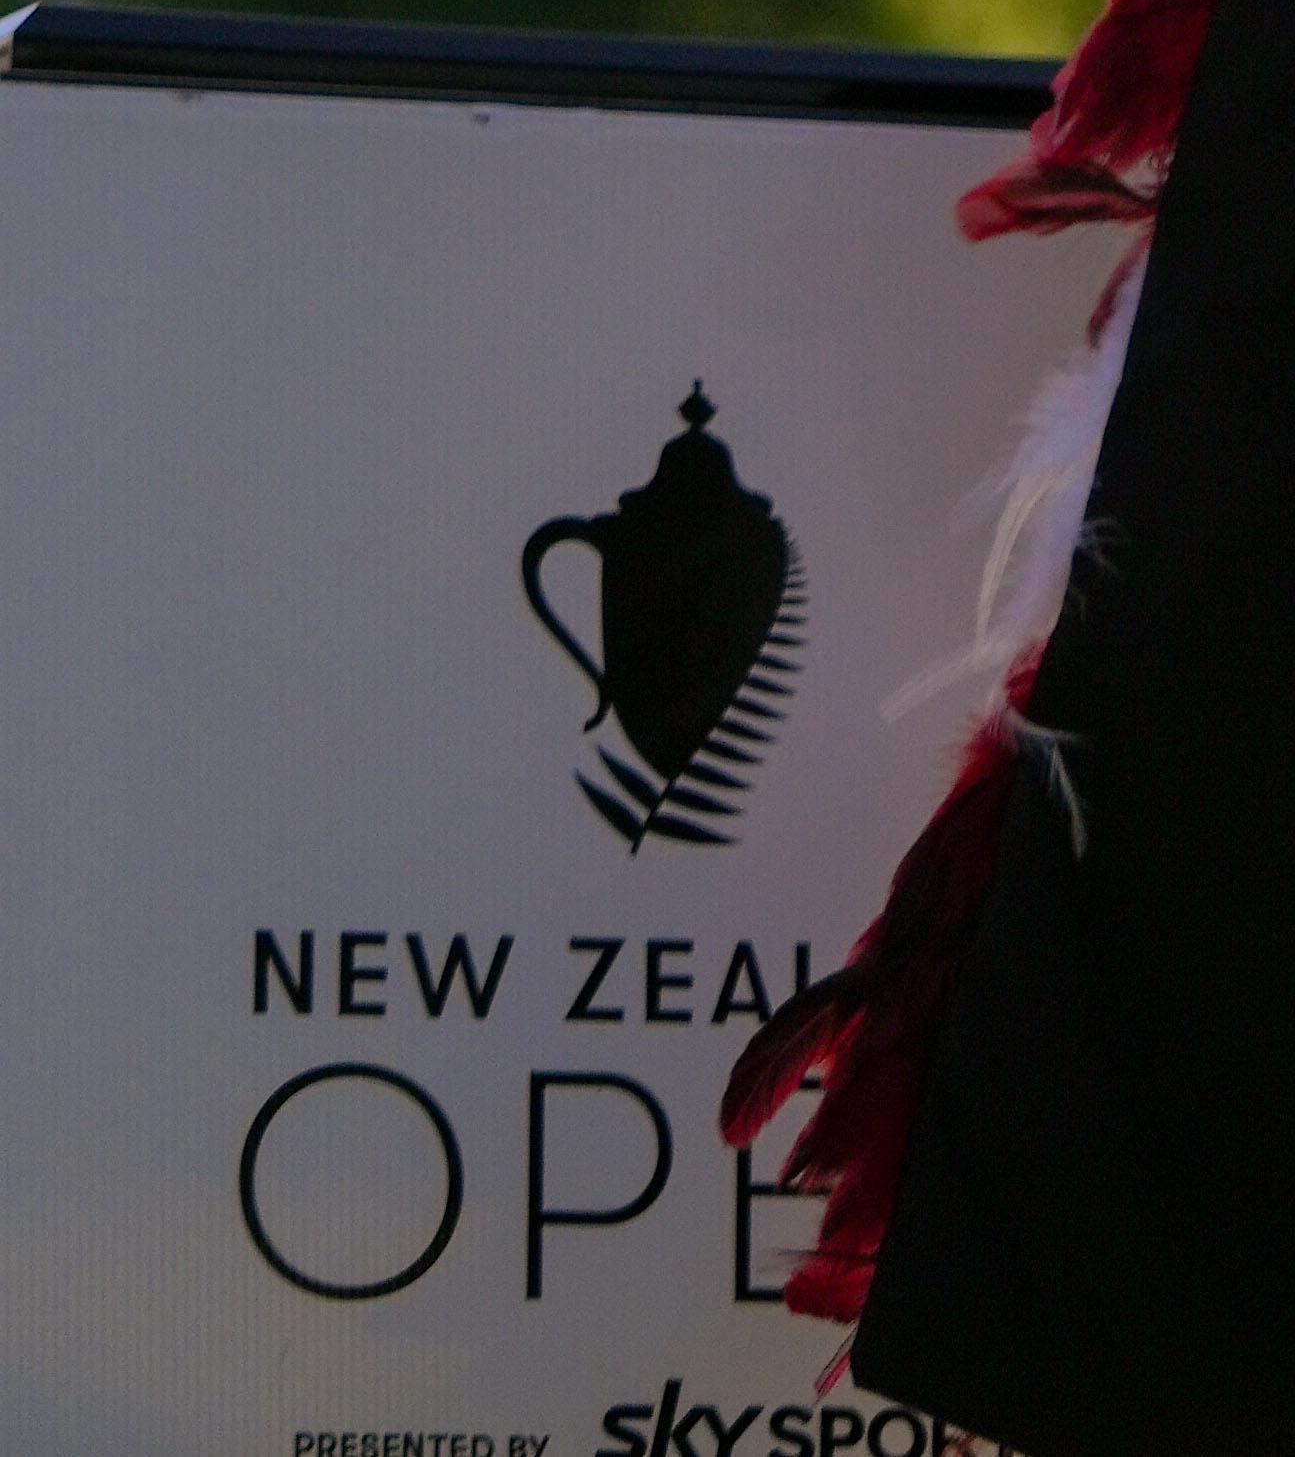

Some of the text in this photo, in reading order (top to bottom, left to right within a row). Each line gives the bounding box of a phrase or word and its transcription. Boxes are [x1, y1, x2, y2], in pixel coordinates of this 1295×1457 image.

[253, 928, 514, 1018] NEW
[293, 1431, 497, 1457] PRESENTED
[508, 1433, 550, 1457] BY
